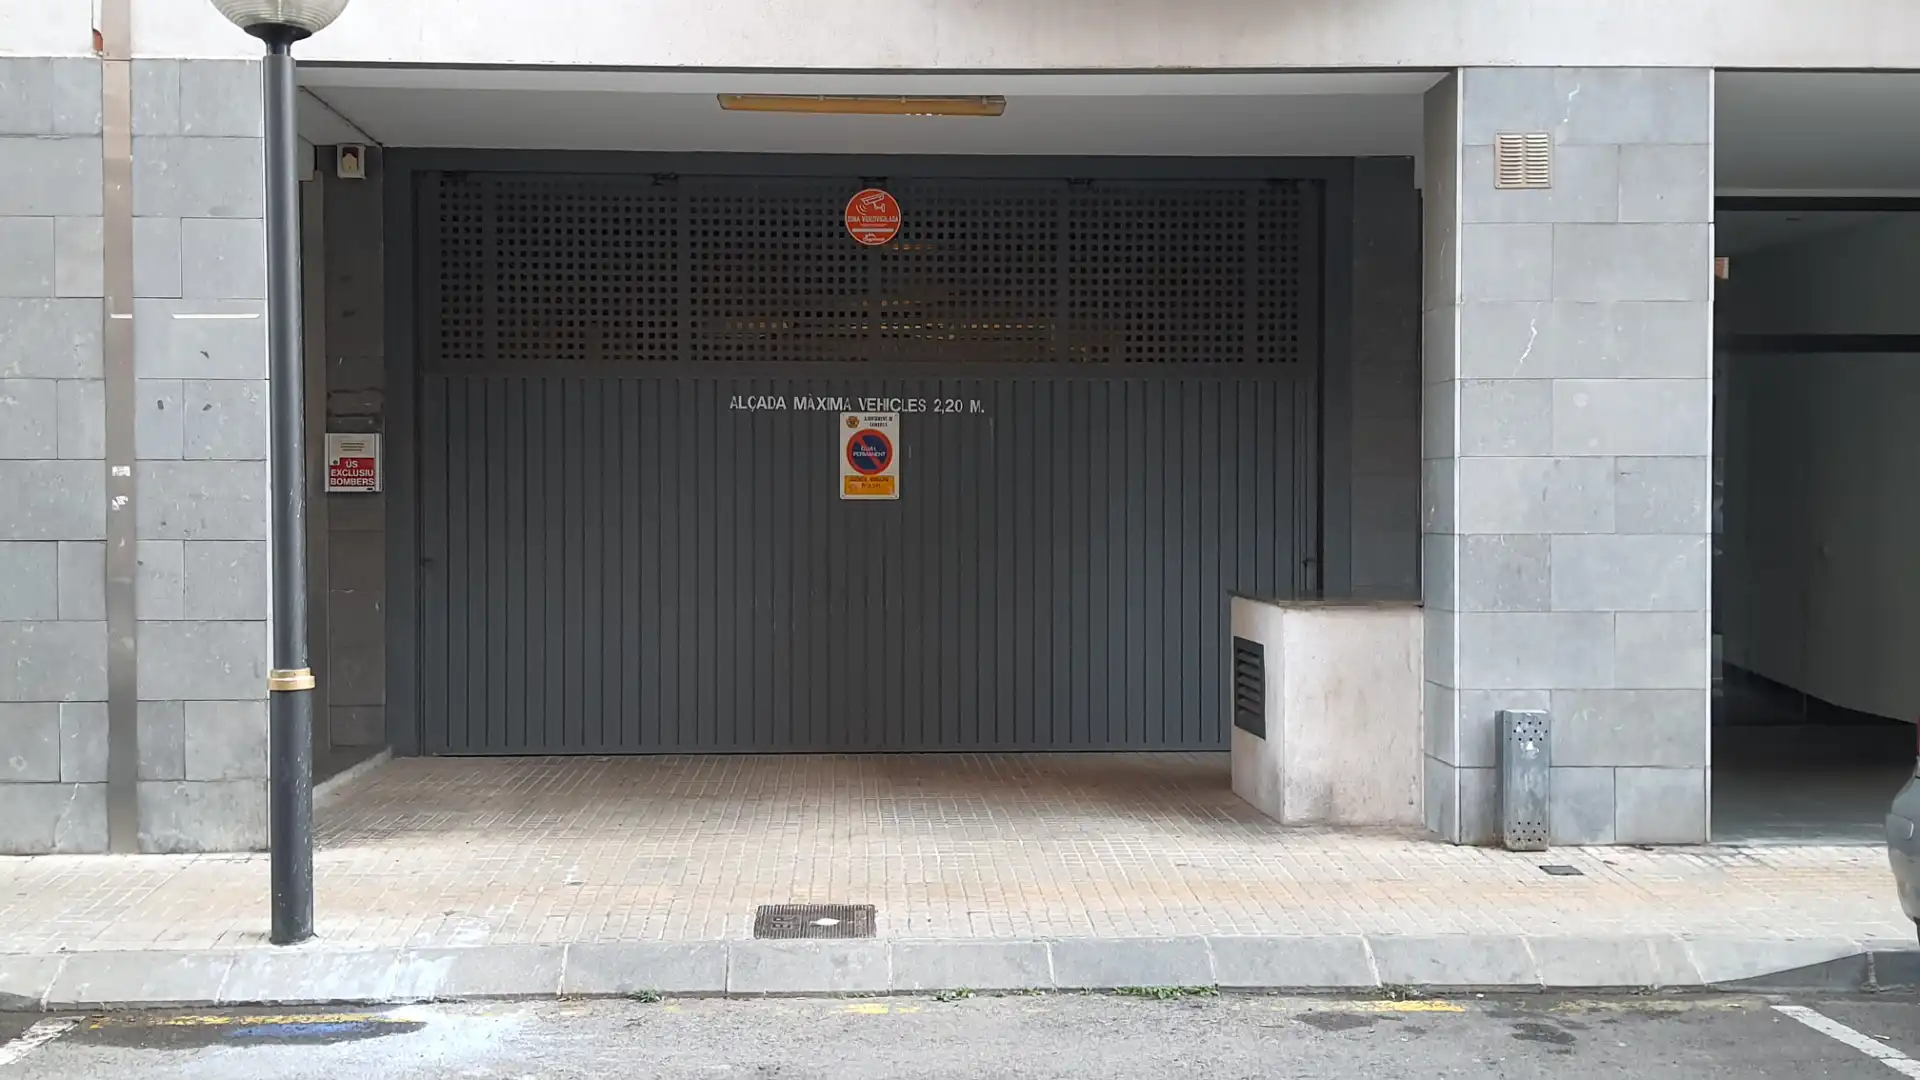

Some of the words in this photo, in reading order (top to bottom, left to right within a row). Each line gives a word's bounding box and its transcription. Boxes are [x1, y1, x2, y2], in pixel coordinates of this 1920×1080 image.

[729, 395, 787, 412] ALÇADA
[857, 397, 927, 413] VEHICLES
[933, 398, 963, 414] 2,20
[969, 399, 985, 413] M.
[345, 458, 359, 468] ÚS
[330, 469, 374, 477] EXCLUSIU
[330, 477, 375, 486] BOMBERS
